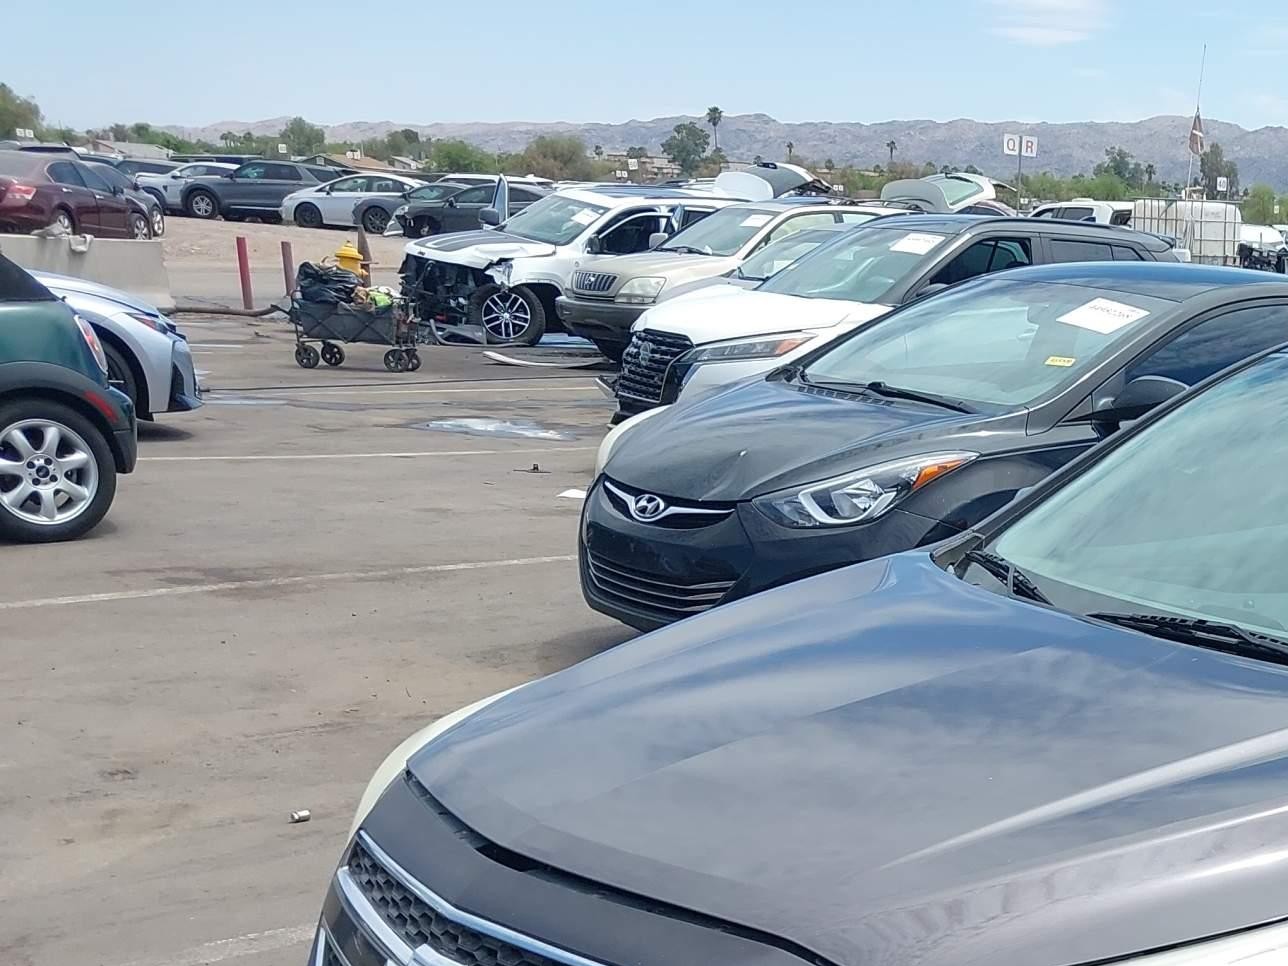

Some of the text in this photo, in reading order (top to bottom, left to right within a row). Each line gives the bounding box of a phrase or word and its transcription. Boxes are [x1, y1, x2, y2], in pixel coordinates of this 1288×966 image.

[1006, 138, 1034, 153] Q R
[1219, 180, 1226, 189] 40
